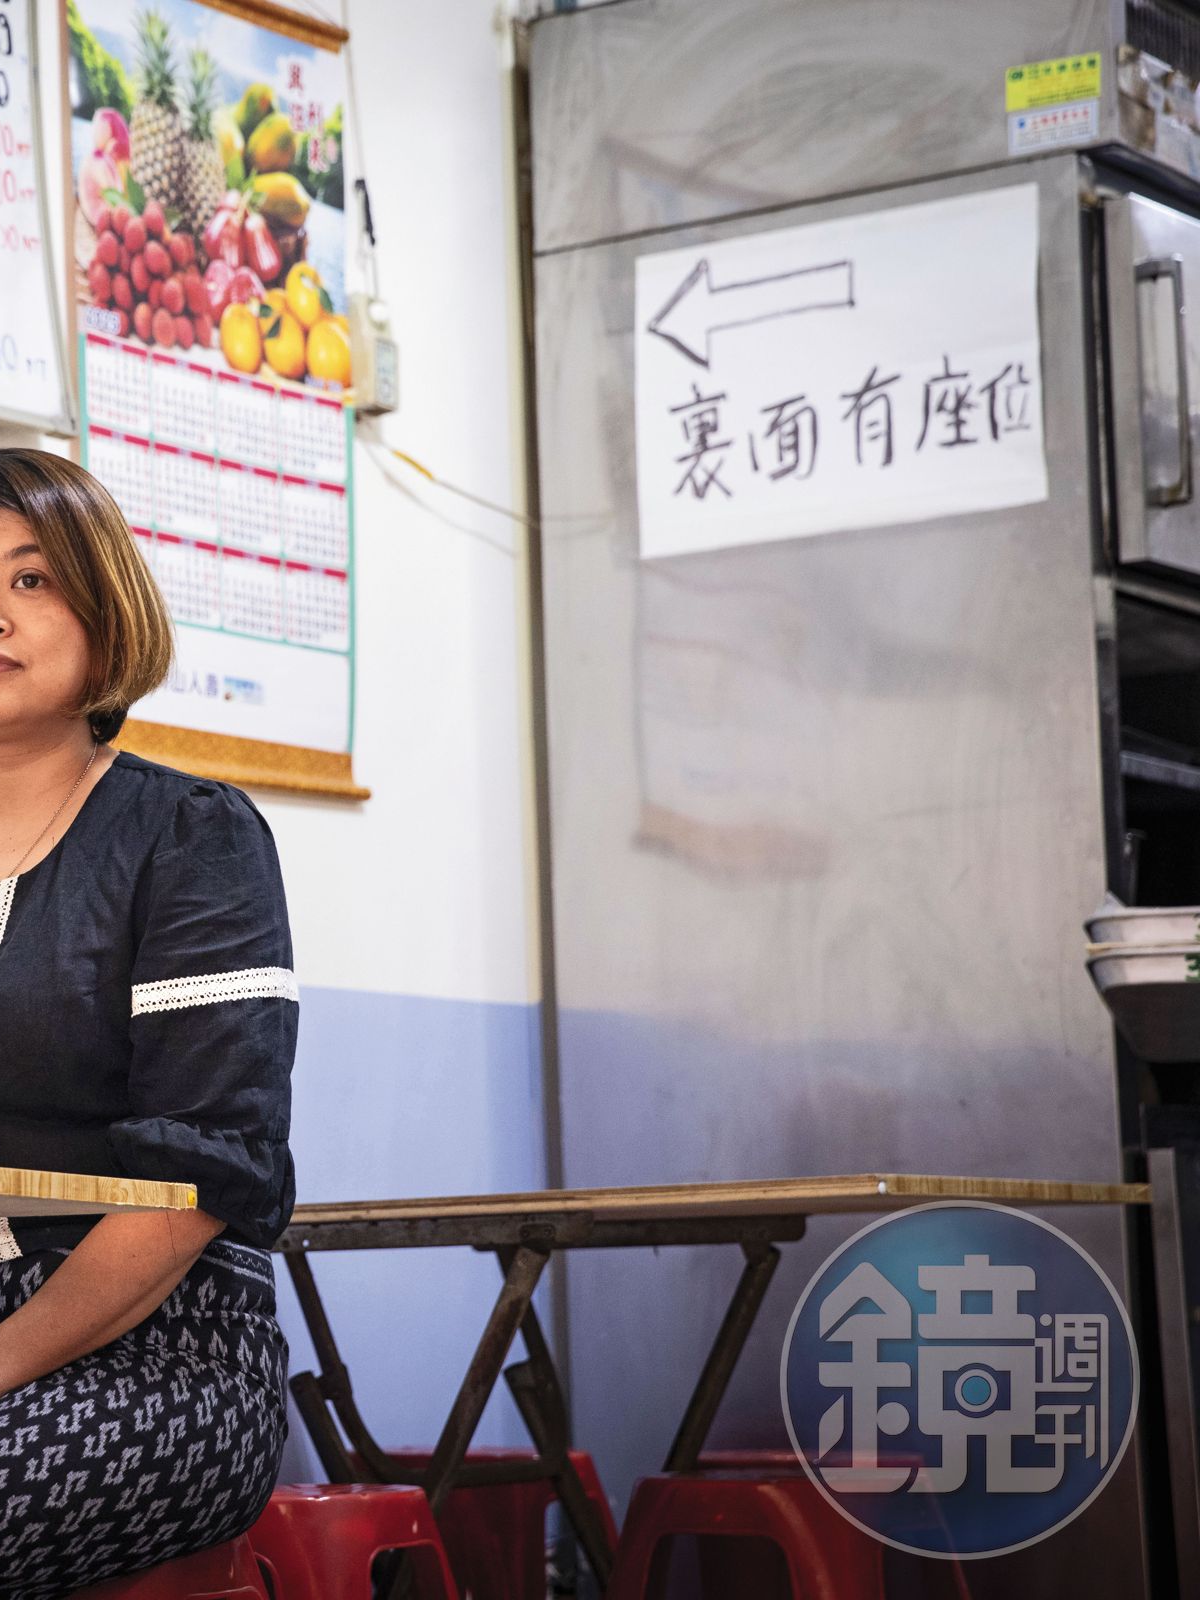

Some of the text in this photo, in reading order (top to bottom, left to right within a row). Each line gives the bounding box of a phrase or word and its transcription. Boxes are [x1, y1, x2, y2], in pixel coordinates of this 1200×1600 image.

[669, 355, 1032, 499] 裏面有座位
